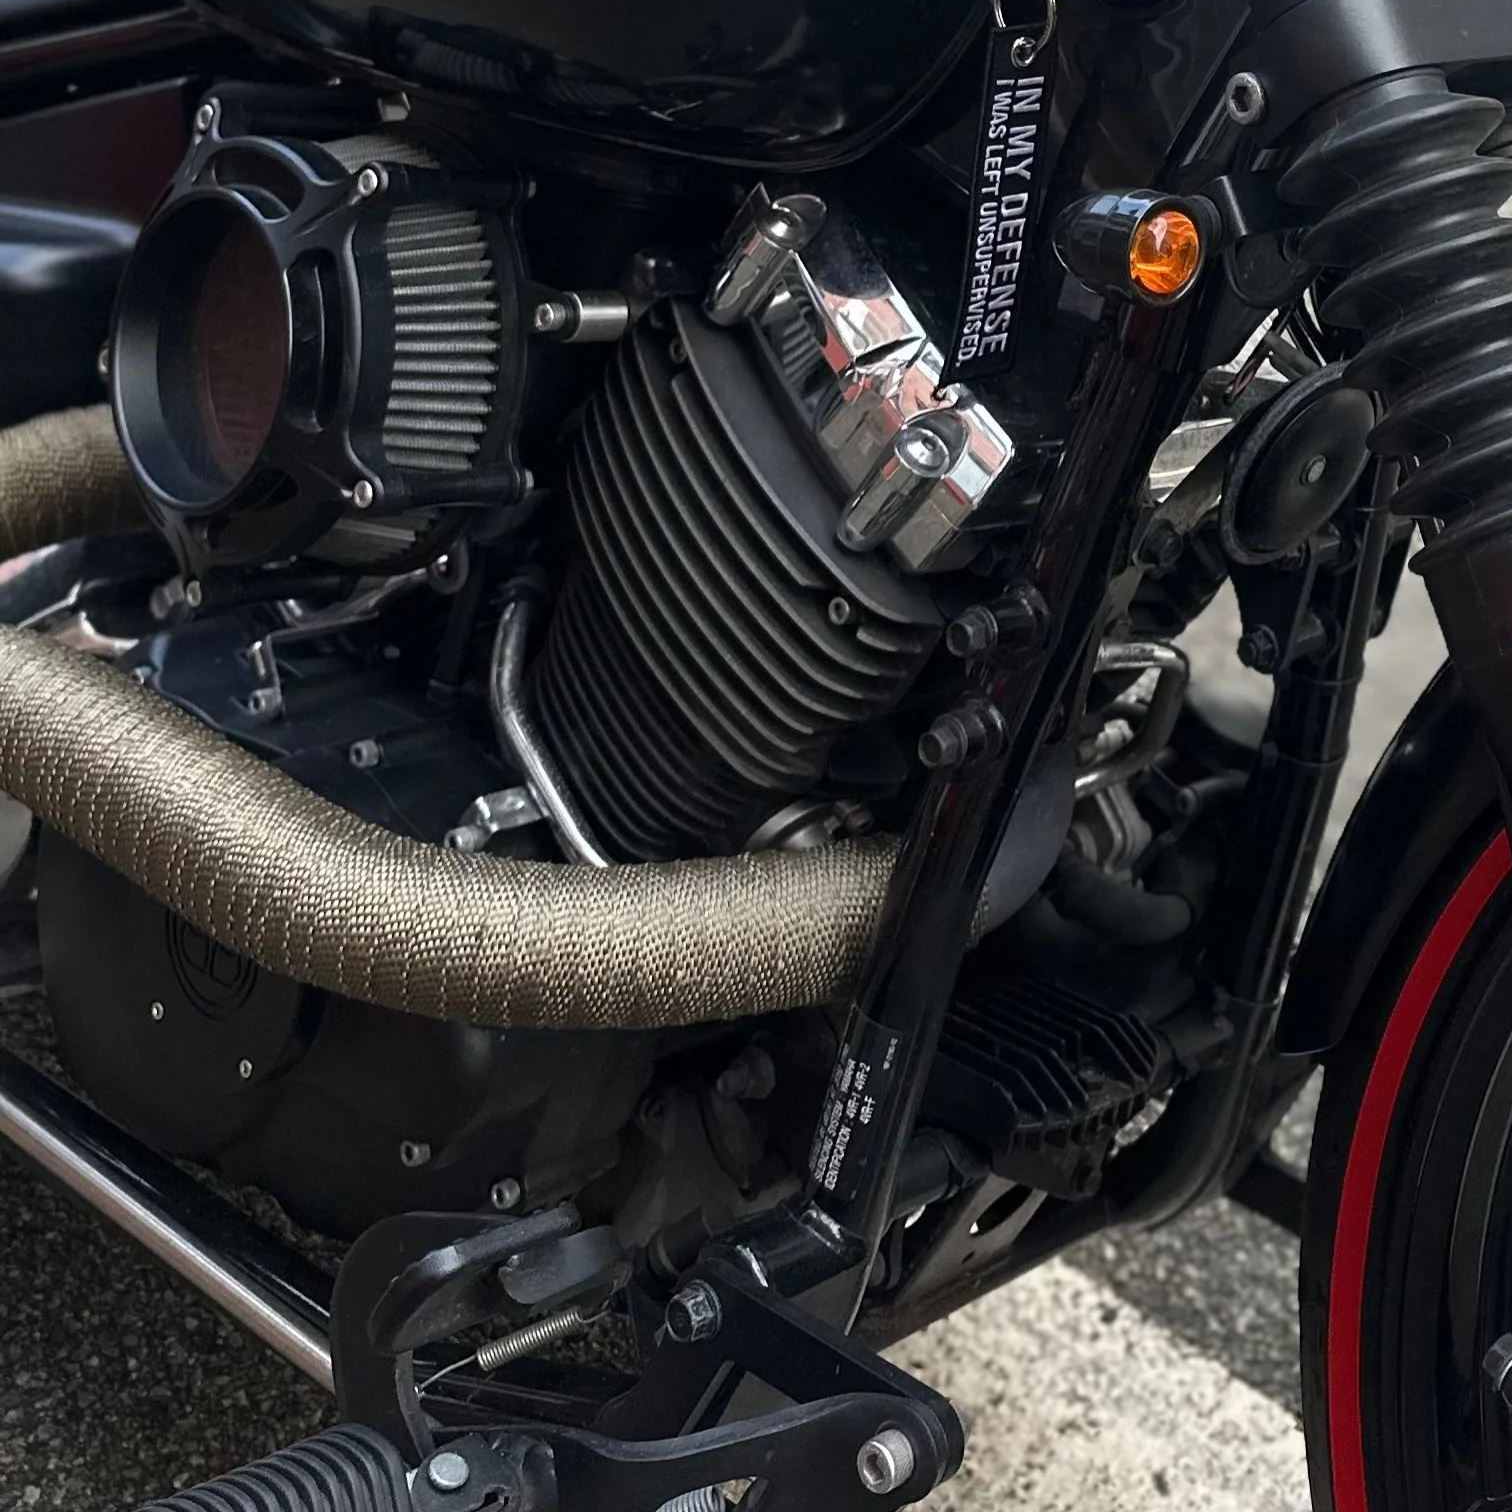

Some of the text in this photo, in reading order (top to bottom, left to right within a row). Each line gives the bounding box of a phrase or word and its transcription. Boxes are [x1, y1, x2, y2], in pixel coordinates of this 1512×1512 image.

[988, 91, 1013, 139] WAS
[978, 76, 1044, 357] IN MY DEFENSE
[981, 144, 1005, 196] LEFT
[955, 201, 998, 368] UNSUPERVISED.
